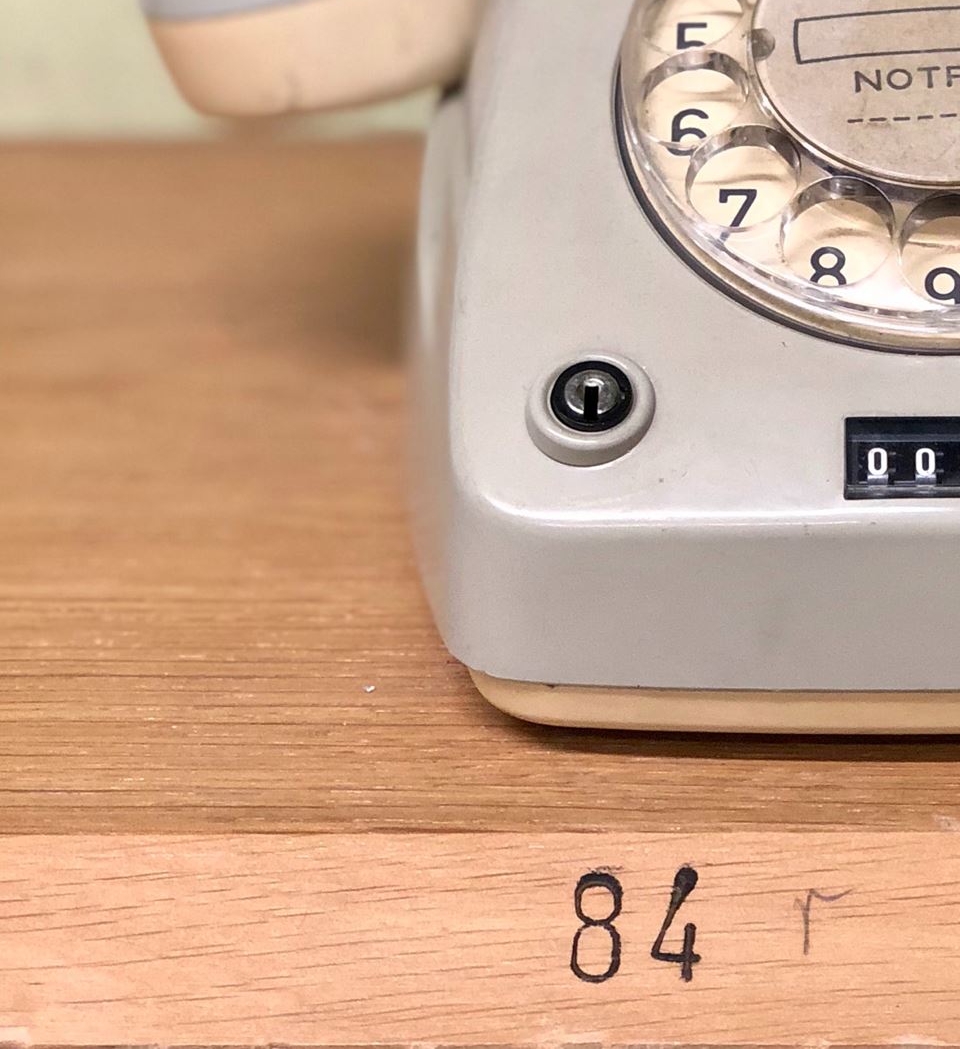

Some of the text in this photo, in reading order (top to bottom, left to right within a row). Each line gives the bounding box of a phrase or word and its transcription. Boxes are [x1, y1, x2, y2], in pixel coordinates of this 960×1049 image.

[667, 108, 710, 156] 6
[717, 188, 758, 240] 7
[809, 246, 847, 287] 8
[569, 864, 702, 984] 84
